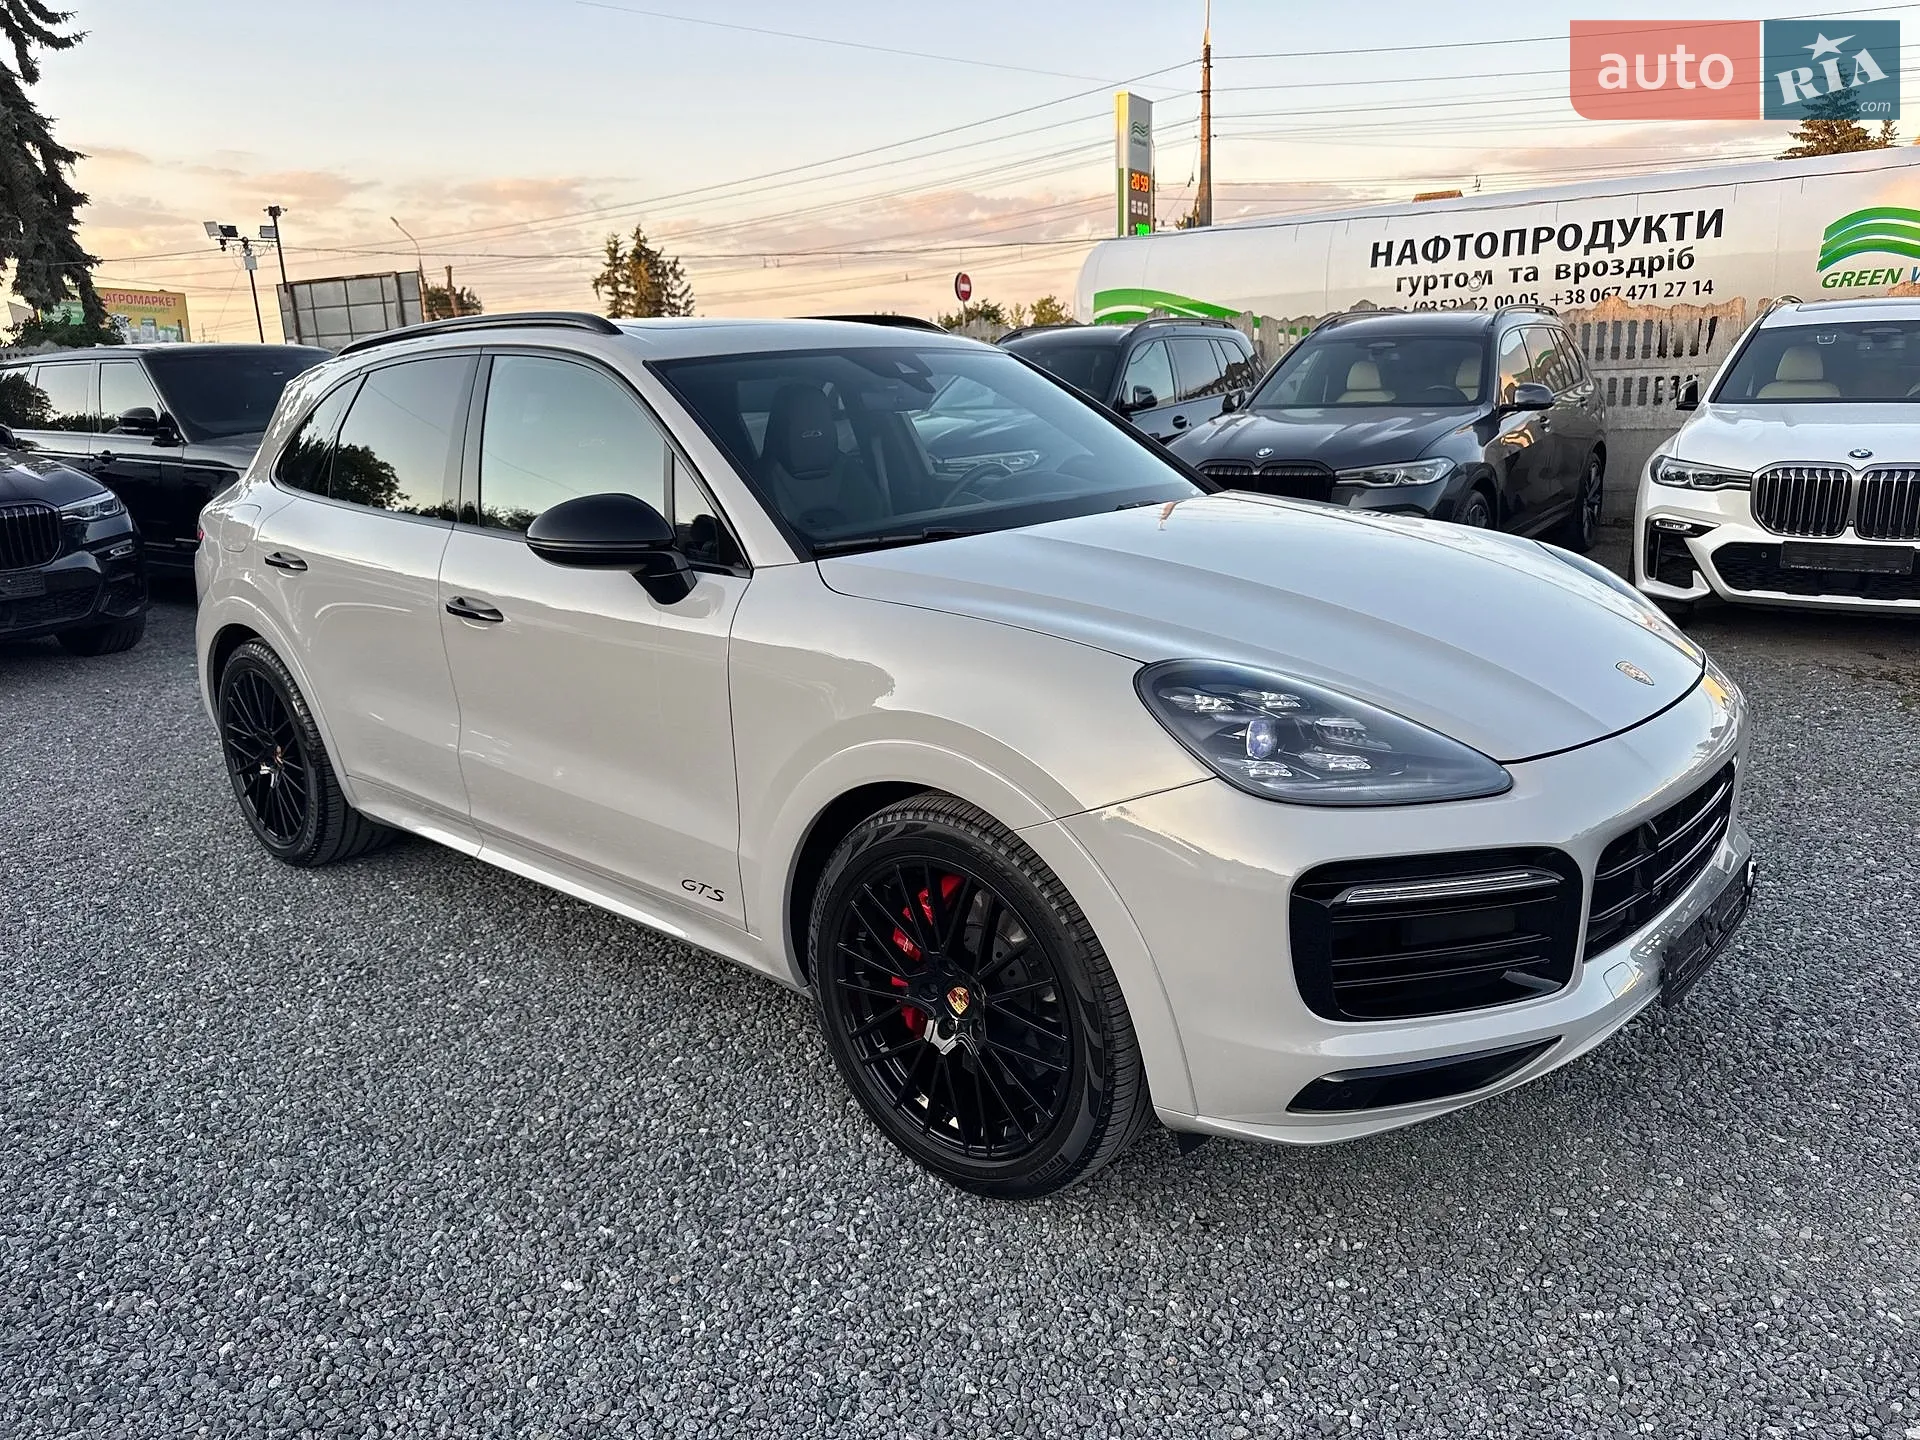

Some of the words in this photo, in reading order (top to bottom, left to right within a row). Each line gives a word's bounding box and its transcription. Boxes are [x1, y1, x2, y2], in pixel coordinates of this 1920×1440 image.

[1370, 208, 1724, 268] НАФТОПРОДУКТИ
[1396, 269, 1493, 297] гуртом
[1508, 266, 1539, 283] та
[1555, 246, 1695, 284] вроздріб
[1821, 267, 1904, 288] GREEN
[104, 293, 177, 307] АГРОМАРКЕТ
[1550, 288, 1585, 306] +38
[1590, 286, 1622, 303] 067
[1626, 283, 1657, 300] 471
[1663, 281, 1687, 298] 27
[1692, 279, 1714, 296] 14
[681, 879, 725, 902] GTS
